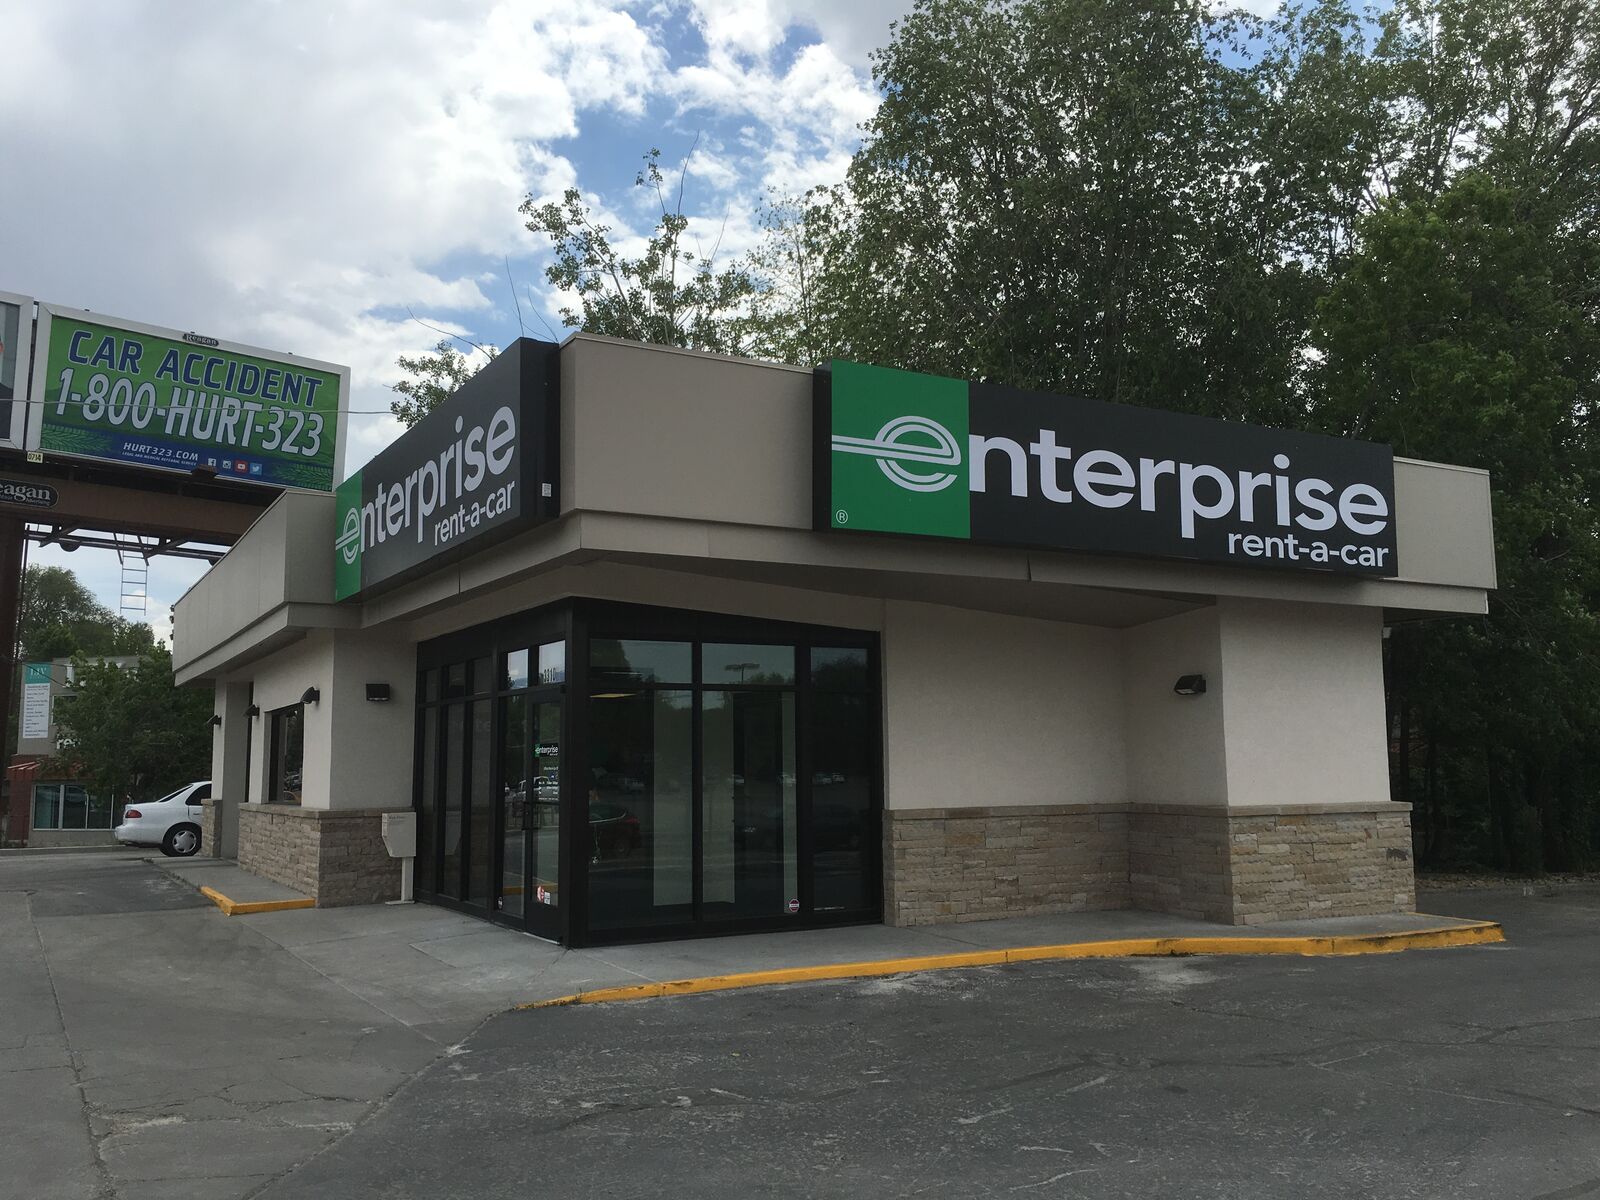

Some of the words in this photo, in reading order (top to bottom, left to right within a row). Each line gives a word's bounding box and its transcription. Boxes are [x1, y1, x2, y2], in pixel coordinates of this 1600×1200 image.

[68, 330, 144, 375] CAR
[155, 348, 323, 407] ACCIDENT
[55, 366, 324, 457] 1-800-HURT-323
[123, 442, 199, 461] HURT323.COM
[336, 406, 516, 565] enterprise
[831, 415, 1389, 539] enterprise
[435, 481, 515, 546] rent-a-car
[1229, 529, 1389, 567] rent-a-car
